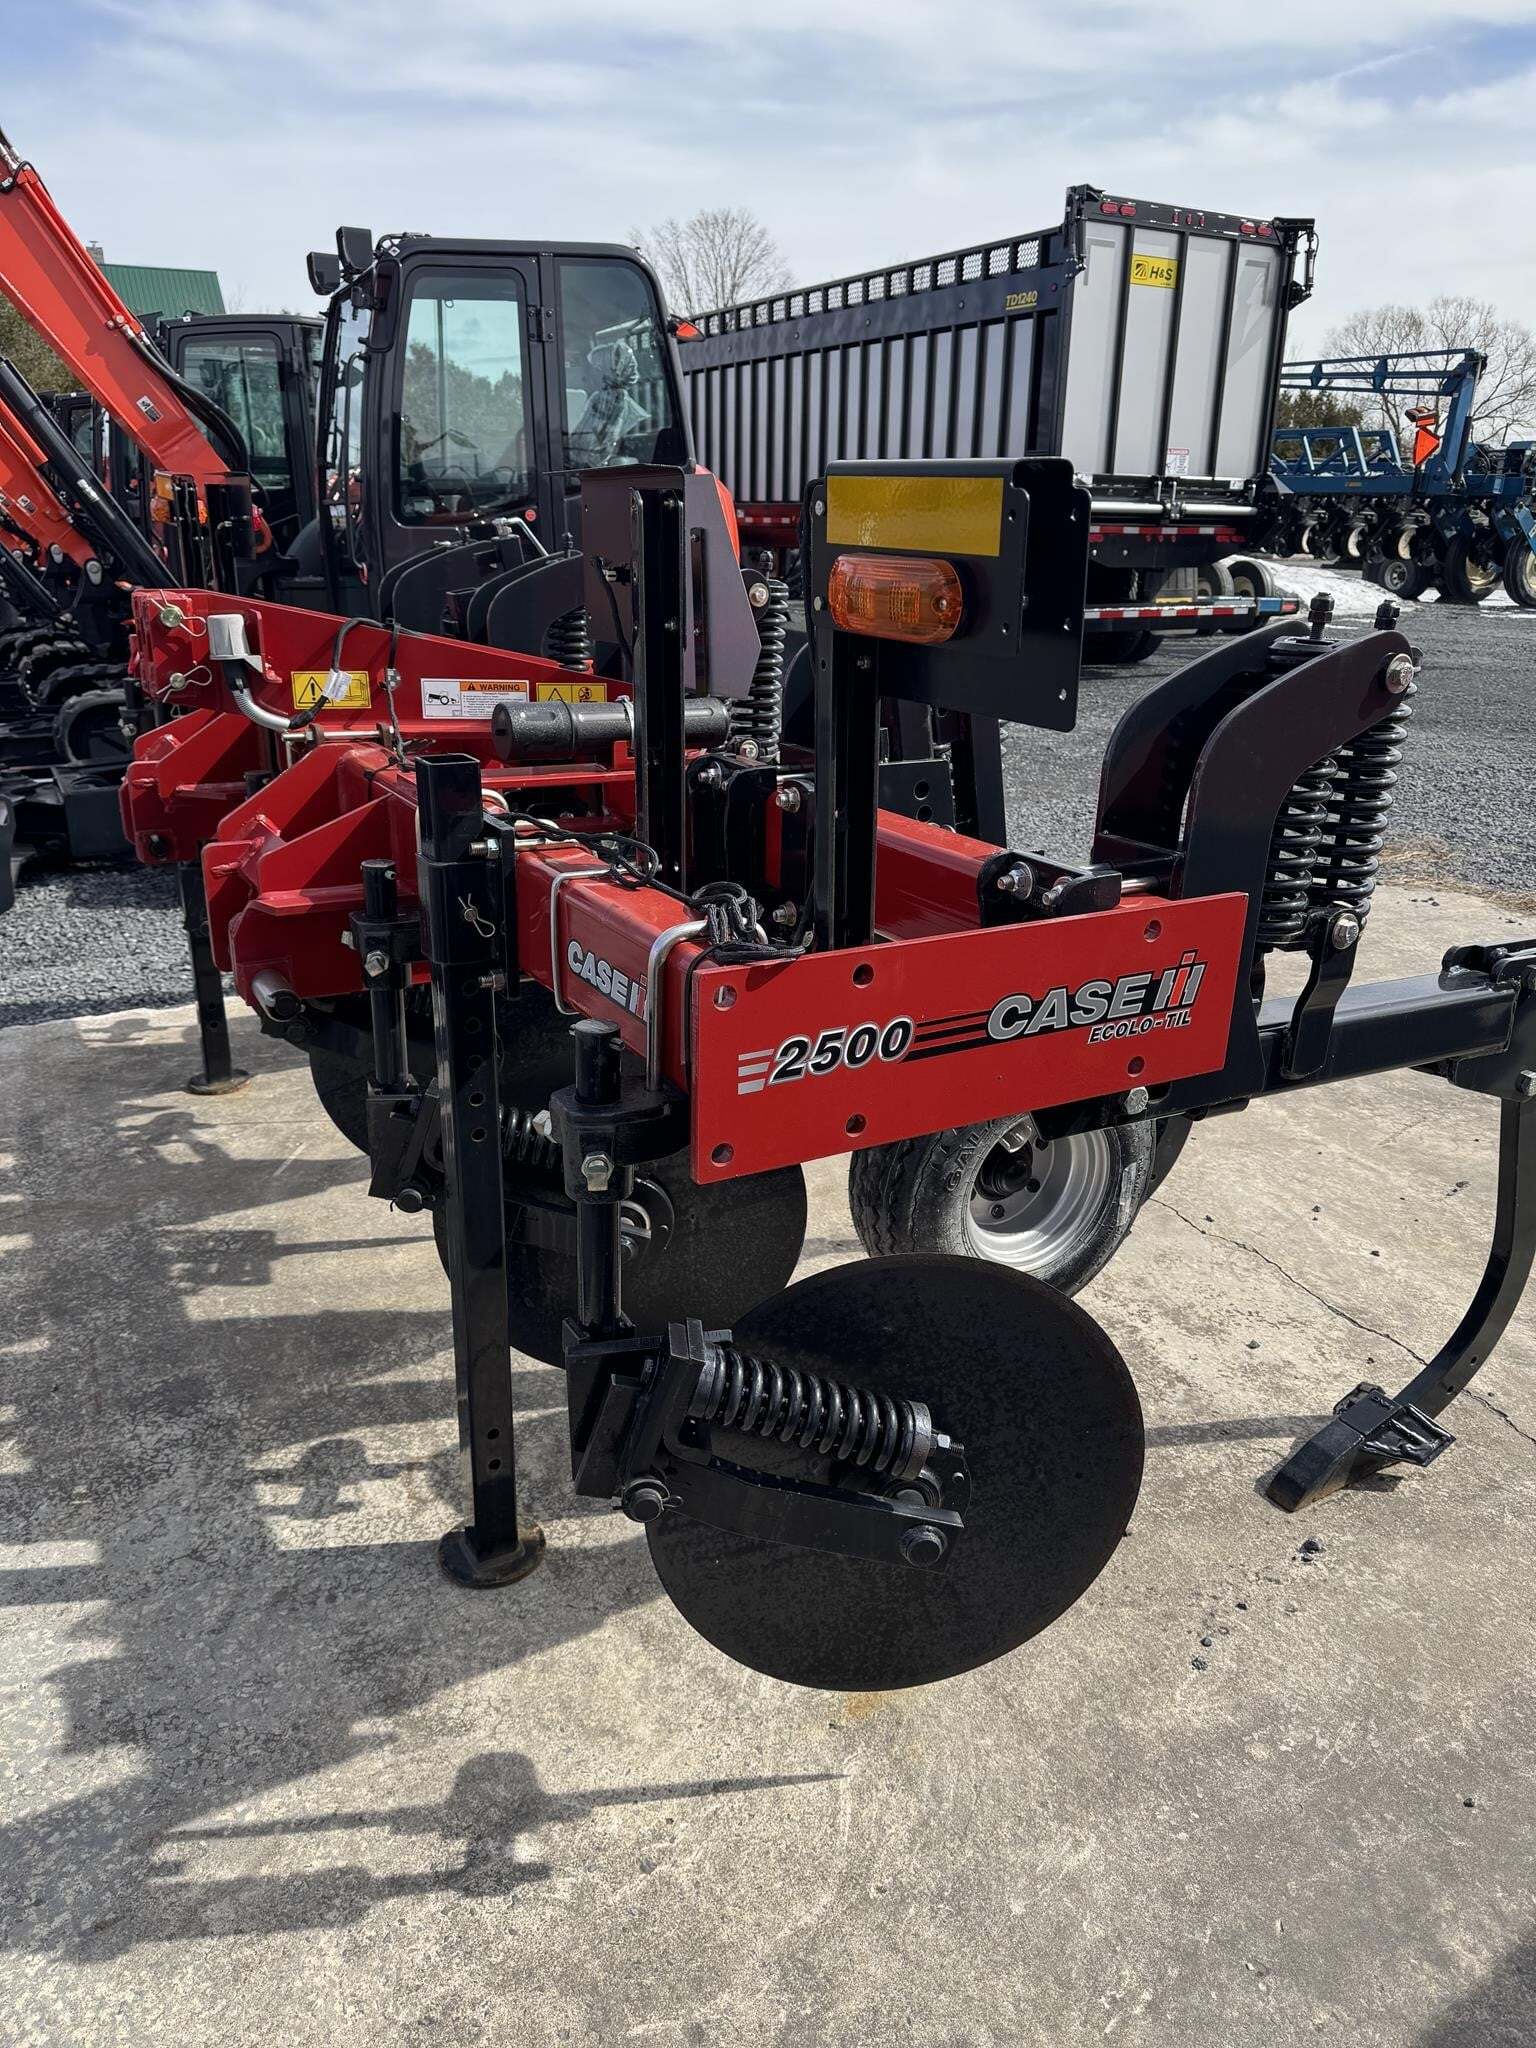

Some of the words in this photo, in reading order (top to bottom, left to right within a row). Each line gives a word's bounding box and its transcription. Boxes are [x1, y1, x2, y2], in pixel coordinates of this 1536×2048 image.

[1149, 265, 1173, 281] H&S
[1006, 290, 1038, 306] TD1240
[479, 683, 520, 691] WARNING
[568, 941, 628, 1007] CASE
[767, 1015, 916, 1086] 2500
[987, 971, 1154, 1041] CASE
[1088, 1010, 1192, 1044] ECOLO-TIL
